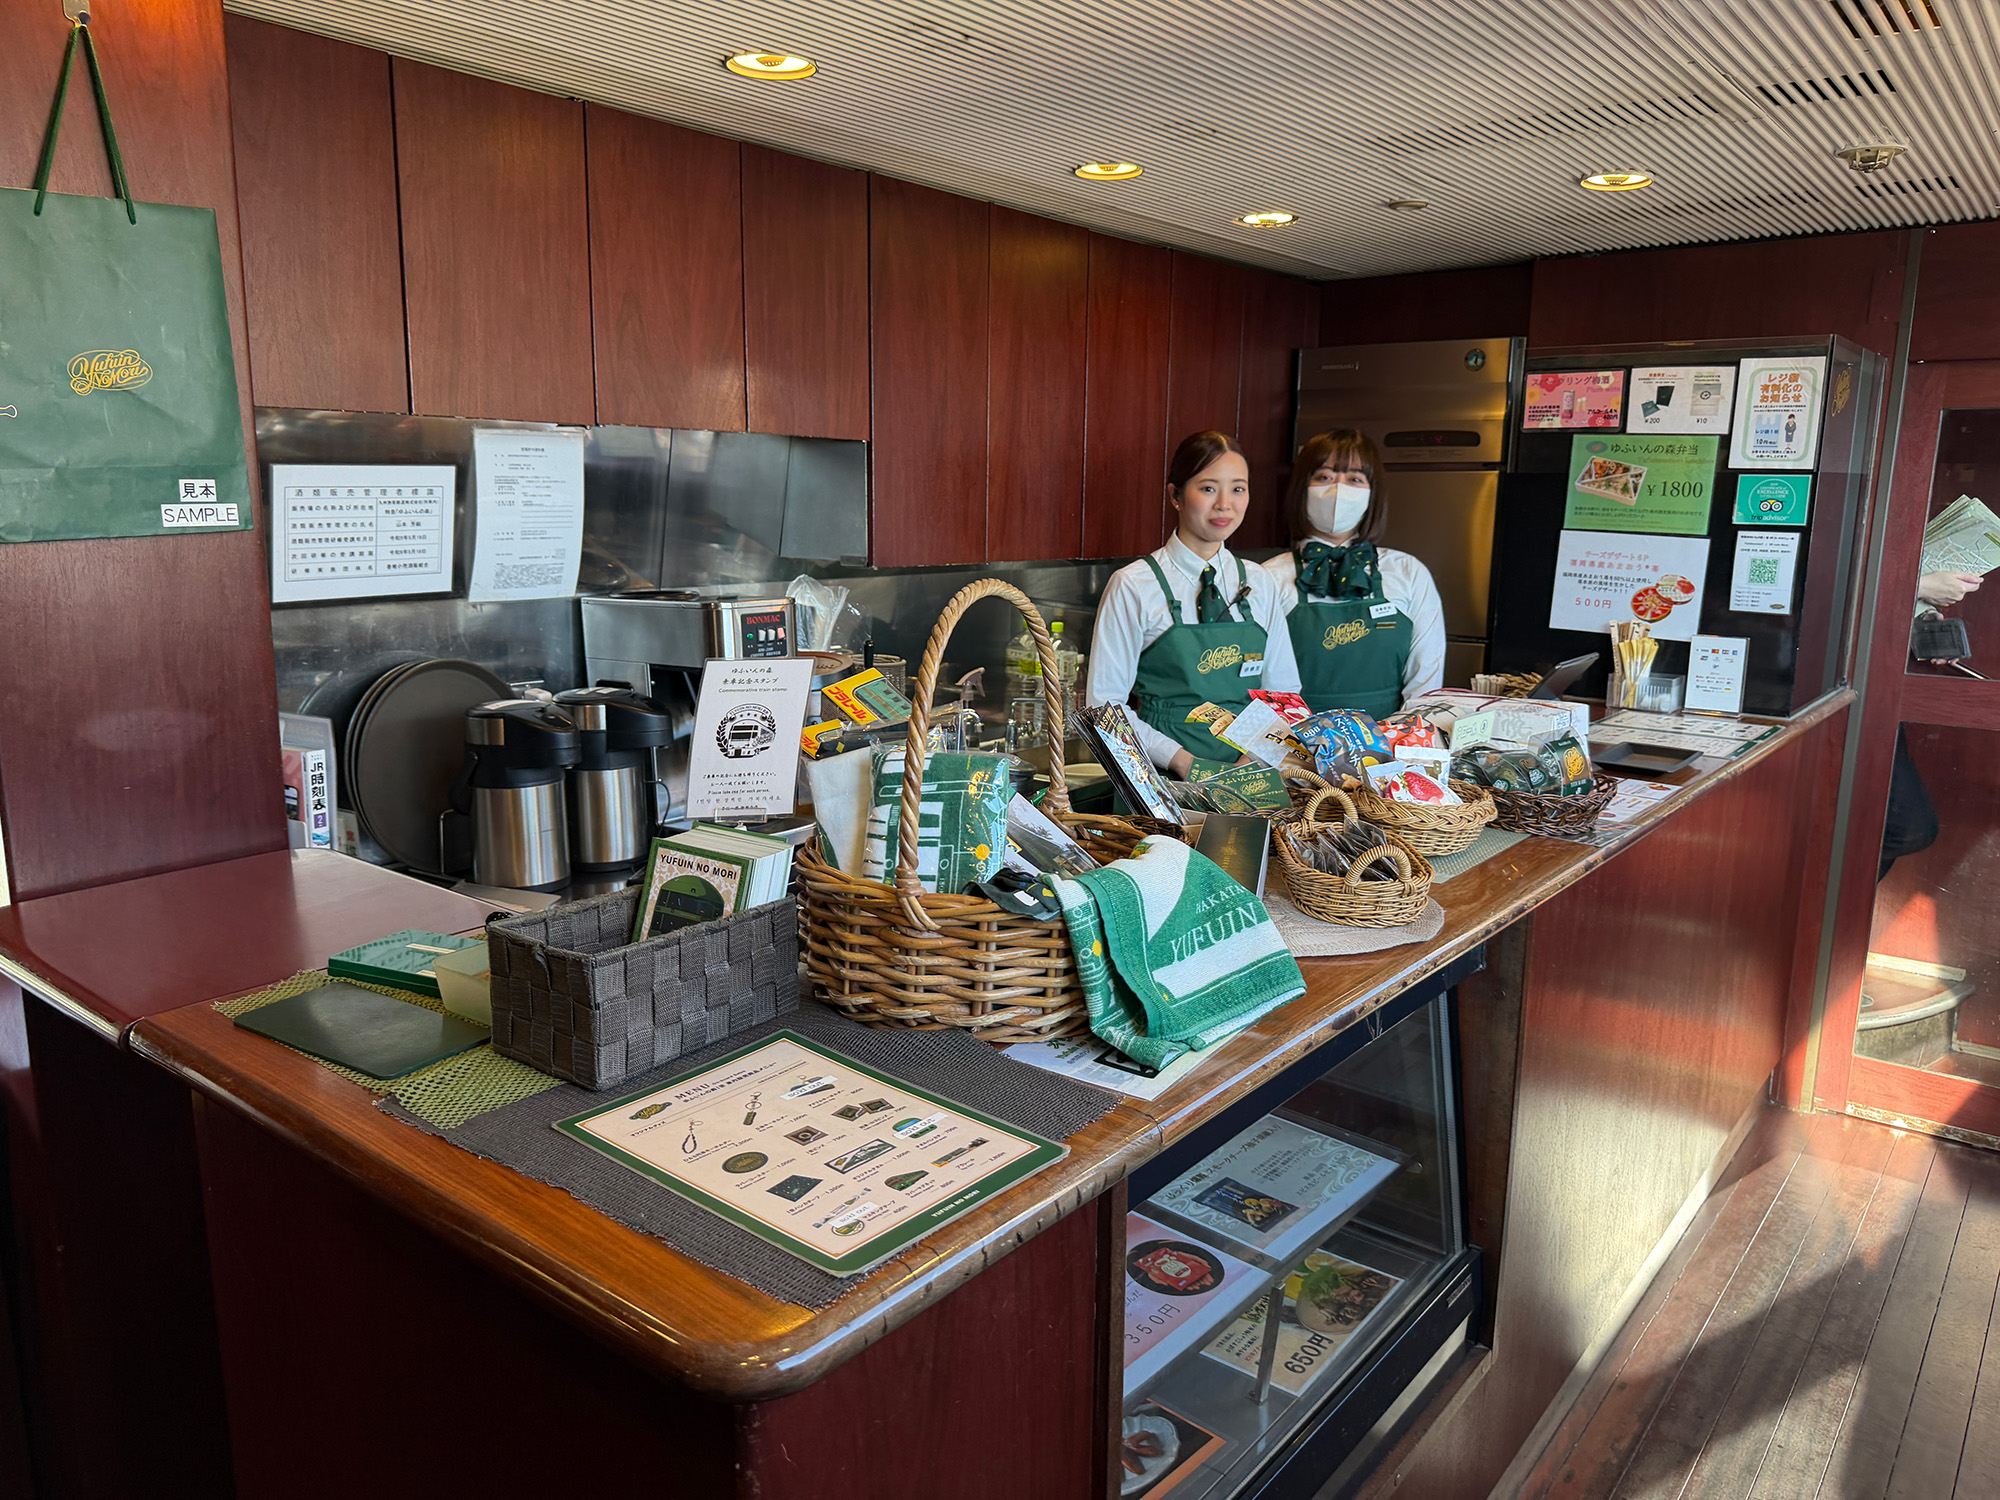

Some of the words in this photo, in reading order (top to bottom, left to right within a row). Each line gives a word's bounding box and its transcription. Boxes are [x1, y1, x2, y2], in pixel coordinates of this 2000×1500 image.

[1768, 373, 1800, 383] レジ袋
[1760, 383, 1803, 394] 有料化の
[1760, 393, 1802, 403] お知らせ
[1610, 444, 1699, 456] ゆふいんの森弁当
[182, 482, 216, 499] 見本
[163, 507, 238, 523] SAMPLE
[746, 614, 781, 625] BONMAC
[827, 686, 867, 721] プラレール
[1303, 726, 1321, 738] QBB
[311, 762, 326, 811] JR時刻表
[660, 854, 693, 869] YUFUIN
[696, 863, 710, 873] NO
[712, 867, 737, 880] MORI
[1169, 902, 1259, 964] YUFUIN
[673, 1083, 711, 1099] MENU
[786, 1087, 807, 1097] sold
[806, 1080, 825, 1089] out
[898, 1125, 921, 1136] sold
[917, 1117, 937, 1126] out
[931, 1204, 955, 1218] YUFUIN
[963, 1189, 980, 1202] MORI
[836, 1212, 855, 1222] sold
[853, 1205, 869, 1213] out
[1124, 1303, 1181, 1344] 350円
[1283, 1332, 1335, 1374] 650円
